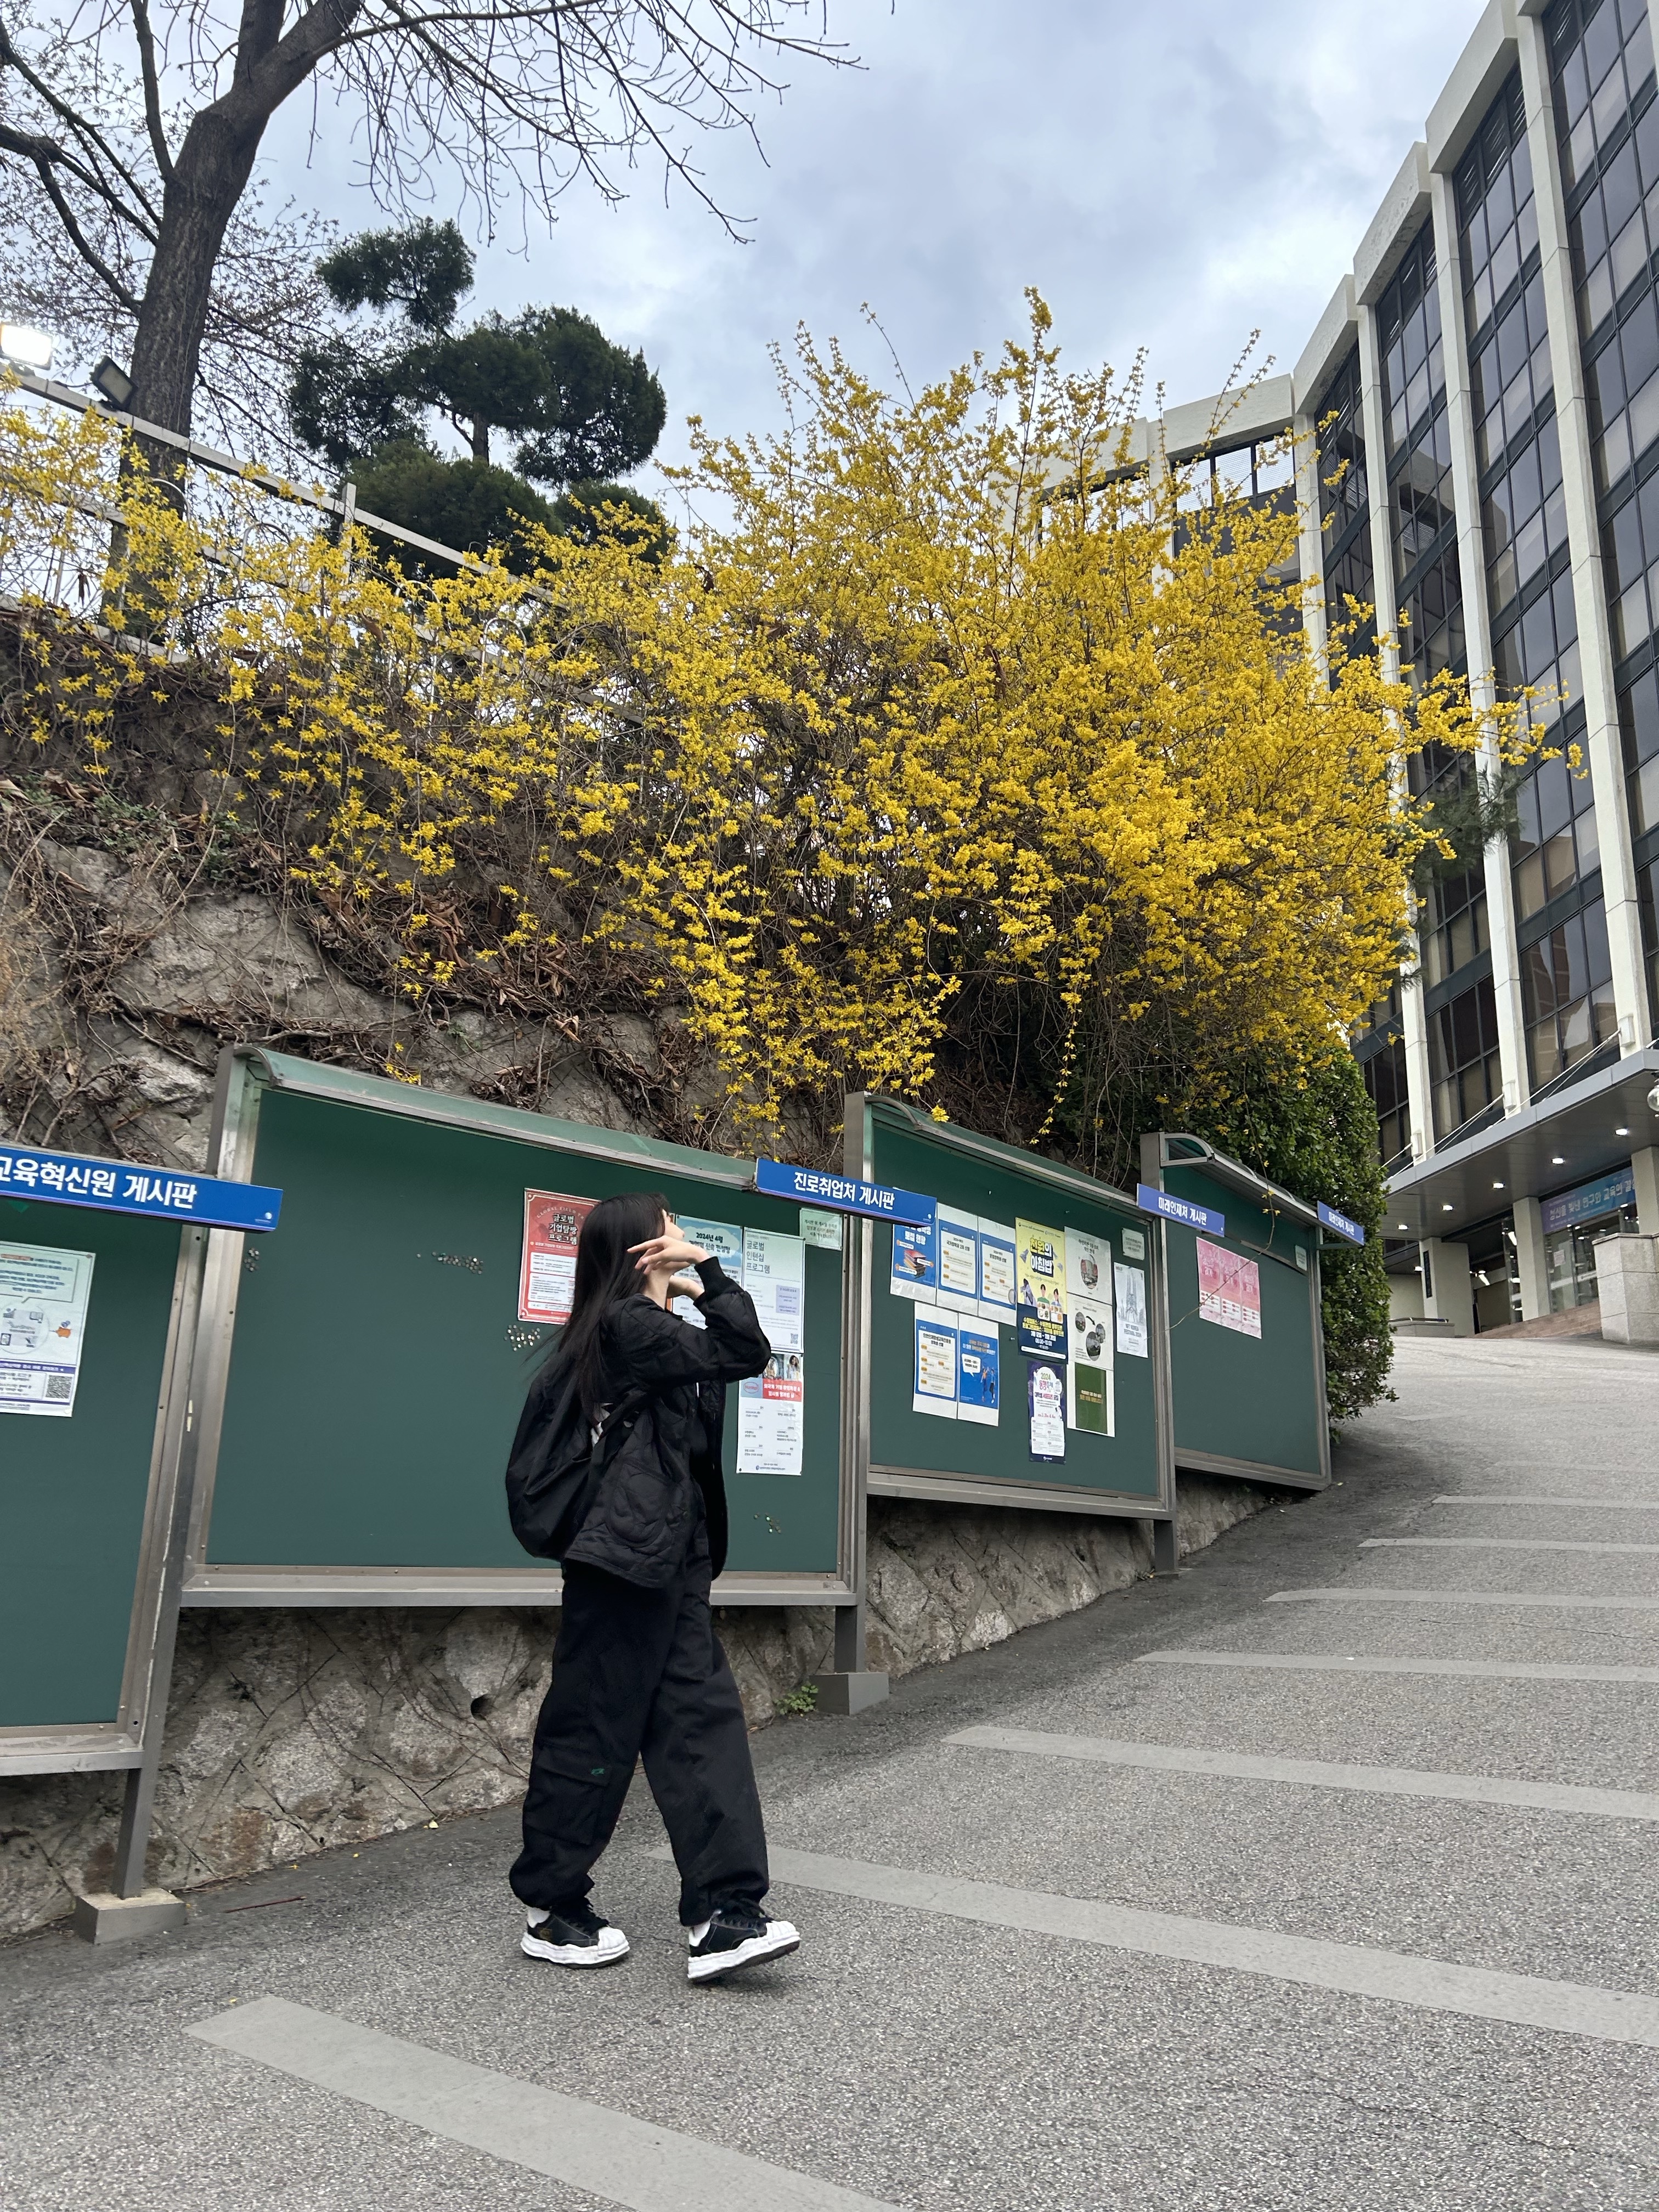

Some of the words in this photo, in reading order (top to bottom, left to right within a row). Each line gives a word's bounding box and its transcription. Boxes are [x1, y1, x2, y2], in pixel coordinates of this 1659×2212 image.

[122, 1175, 198, 1209] 게시판
[794, 1171, 856, 1201] 진로취업처
[859, 1186, 895, 1210] 게시판
[1158, 1197, 1188, 1219] 미래인재처
[1189, 1208, 1207, 1226] 게시판
[553, 1213, 574, 1224] 글로벌
[549, 1223, 578, 1235] 기업탐방
[548, 1234, 577, 1245] 프로그램
[696, 1232, 714, 1242] 2024년
[747, 1240, 764, 1251] 글로벌
[1030, 1237, 1052, 1257] 천원의
[746, 1251, 764, 1262] 인턴십
[746, 1262, 770, 1274] 프로그램
[1030, 1255, 1052, 1274] 아침밥
[1041, 1373, 1051, 1381] 2024
